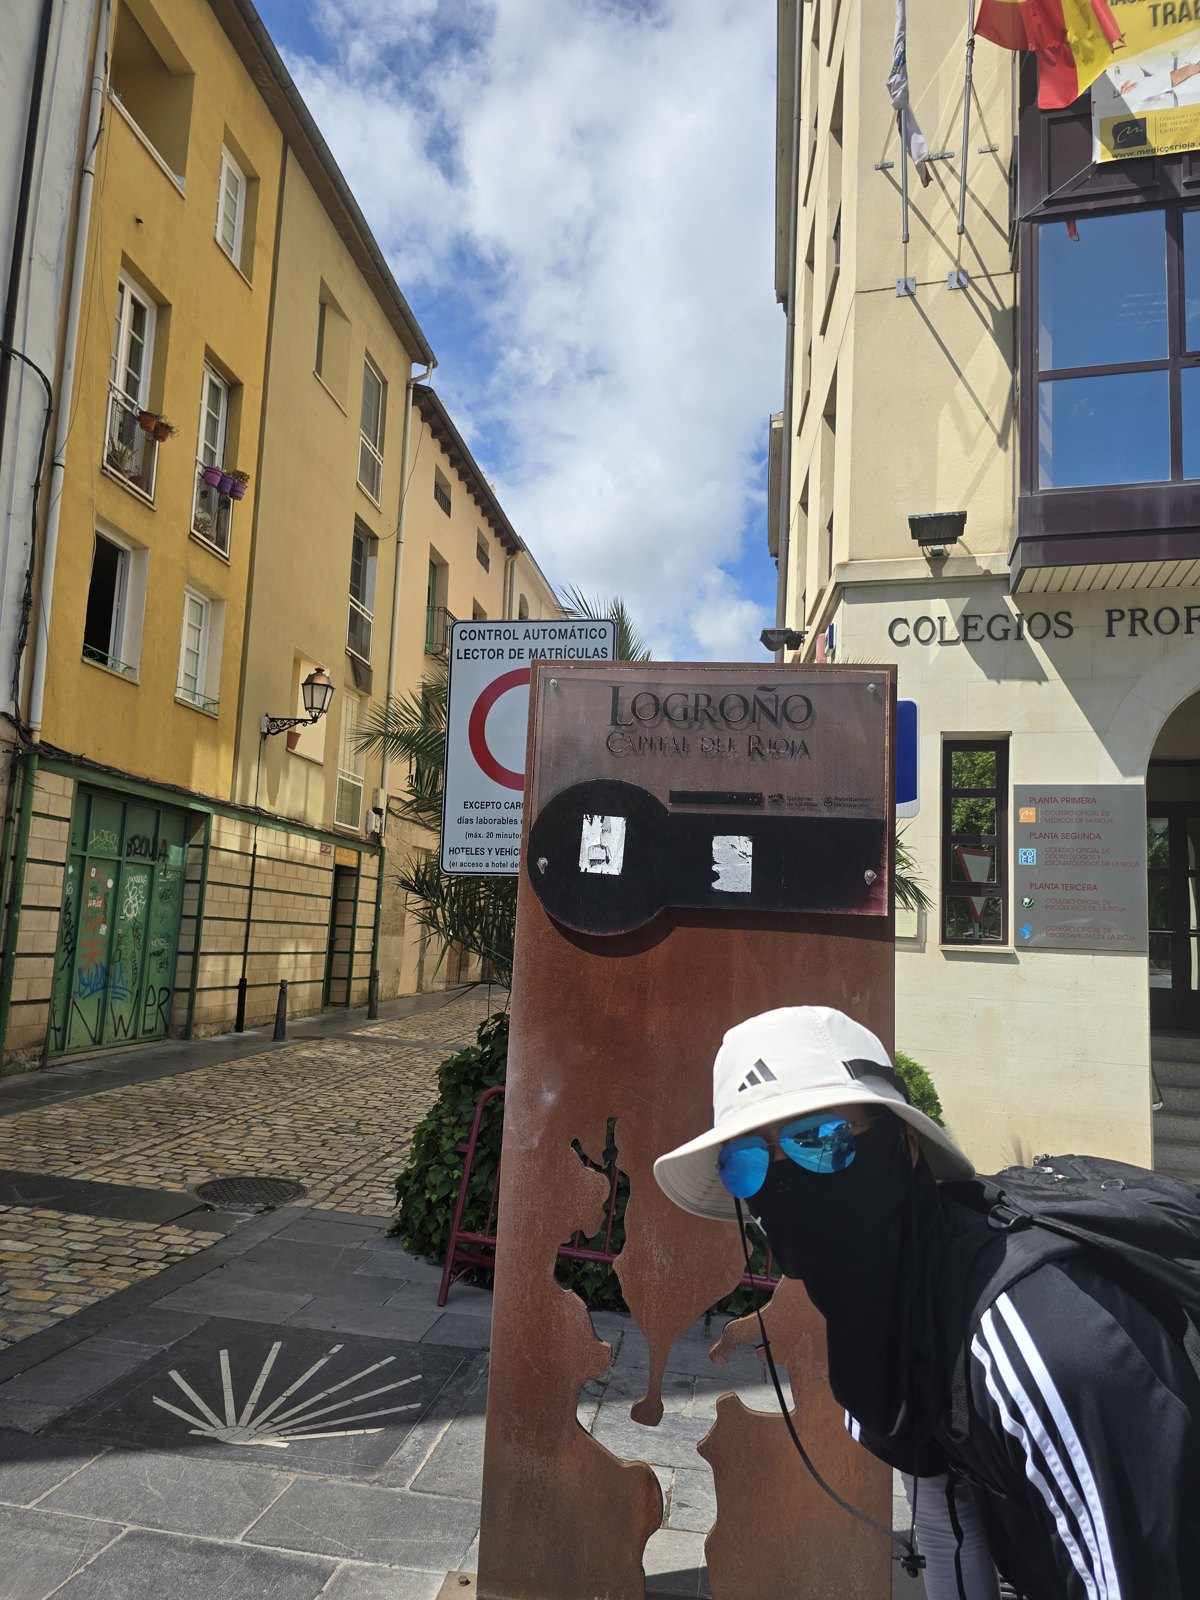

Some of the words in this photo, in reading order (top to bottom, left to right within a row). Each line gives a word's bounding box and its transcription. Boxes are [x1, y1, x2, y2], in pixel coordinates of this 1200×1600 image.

[459, 629, 519, 640] CONTROL
[523, 626, 608, 640] AUTOMÁTICO
[888, 611, 1074, 646] COLEGIOS
[456, 648, 504, 660] LECTOR
[508, 648, 524, 660] DE
[528, 645, 608, 660] MATRÍCULAS
[606, 686, 814, 726] LOGROÑO
[463, 801, 502, 809] EXCEPTO
[457, 816, 474, 824] días
[476, 816, 518, 825] laborables
[448, 847, 485, 856] HOTELES
[495, 846, 520, 856] VEHÍC
[1061, 883, 1098, 891] TERCERA
